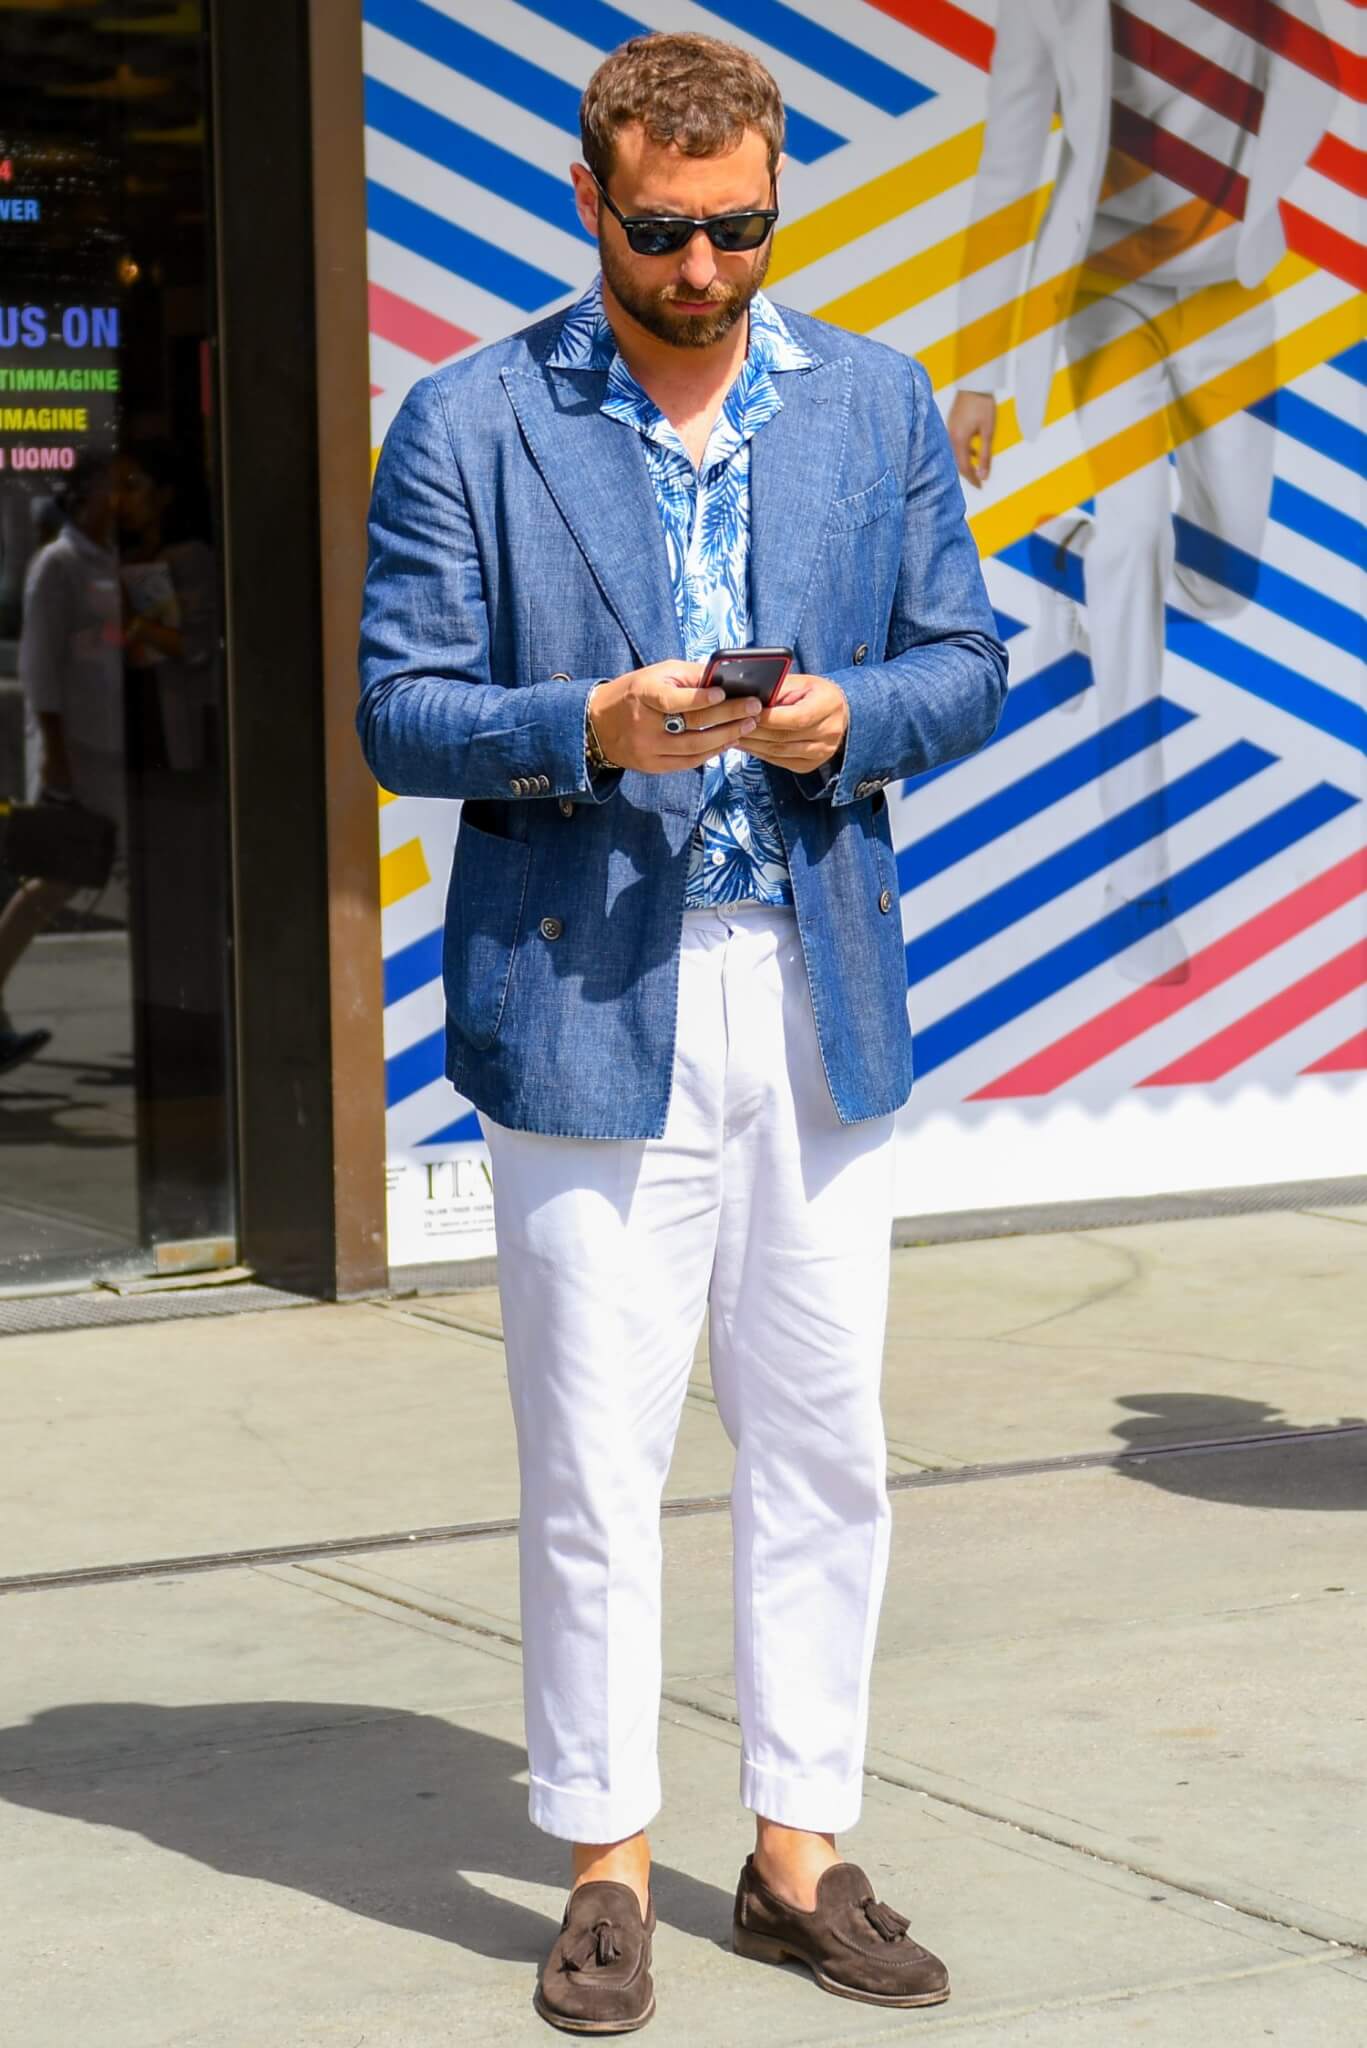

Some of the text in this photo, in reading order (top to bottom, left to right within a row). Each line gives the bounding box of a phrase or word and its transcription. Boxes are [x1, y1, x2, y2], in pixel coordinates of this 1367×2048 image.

[0, 306, 119, 348] US ON
[11, 447, 76, 469] UOMO
